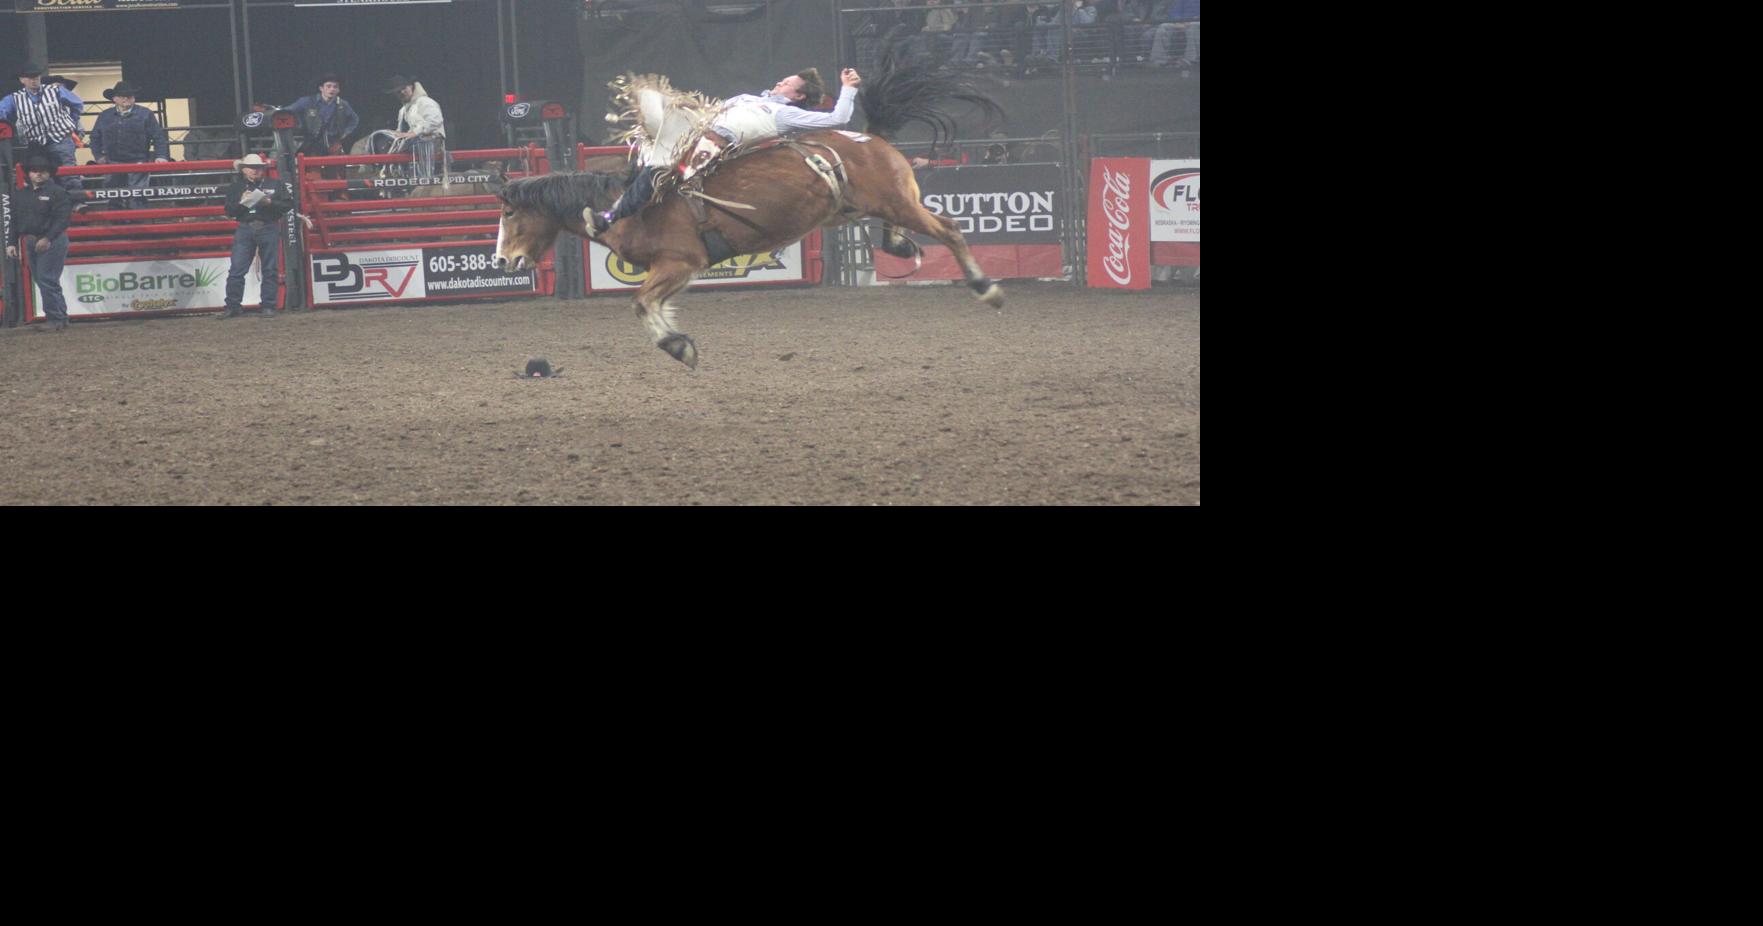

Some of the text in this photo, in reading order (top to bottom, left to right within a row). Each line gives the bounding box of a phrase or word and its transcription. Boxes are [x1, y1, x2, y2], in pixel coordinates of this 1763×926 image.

[374, 175, 490, 187] RODEO RPID CITY
[96, 189, 154, 198] RODEO
[158, 187, 191, 196] RAPID
[1173, 185, 1200, 202] FL
[923, 191, 1055, 215] SUTTON
[951, 214, 1054, 233] ODEO
[429, 253, 499, 272] 605-388-8
[76, 269, 202, 293] BioBarrel
[427, 275, 530, 291] www.dakotadiscountrv.com
